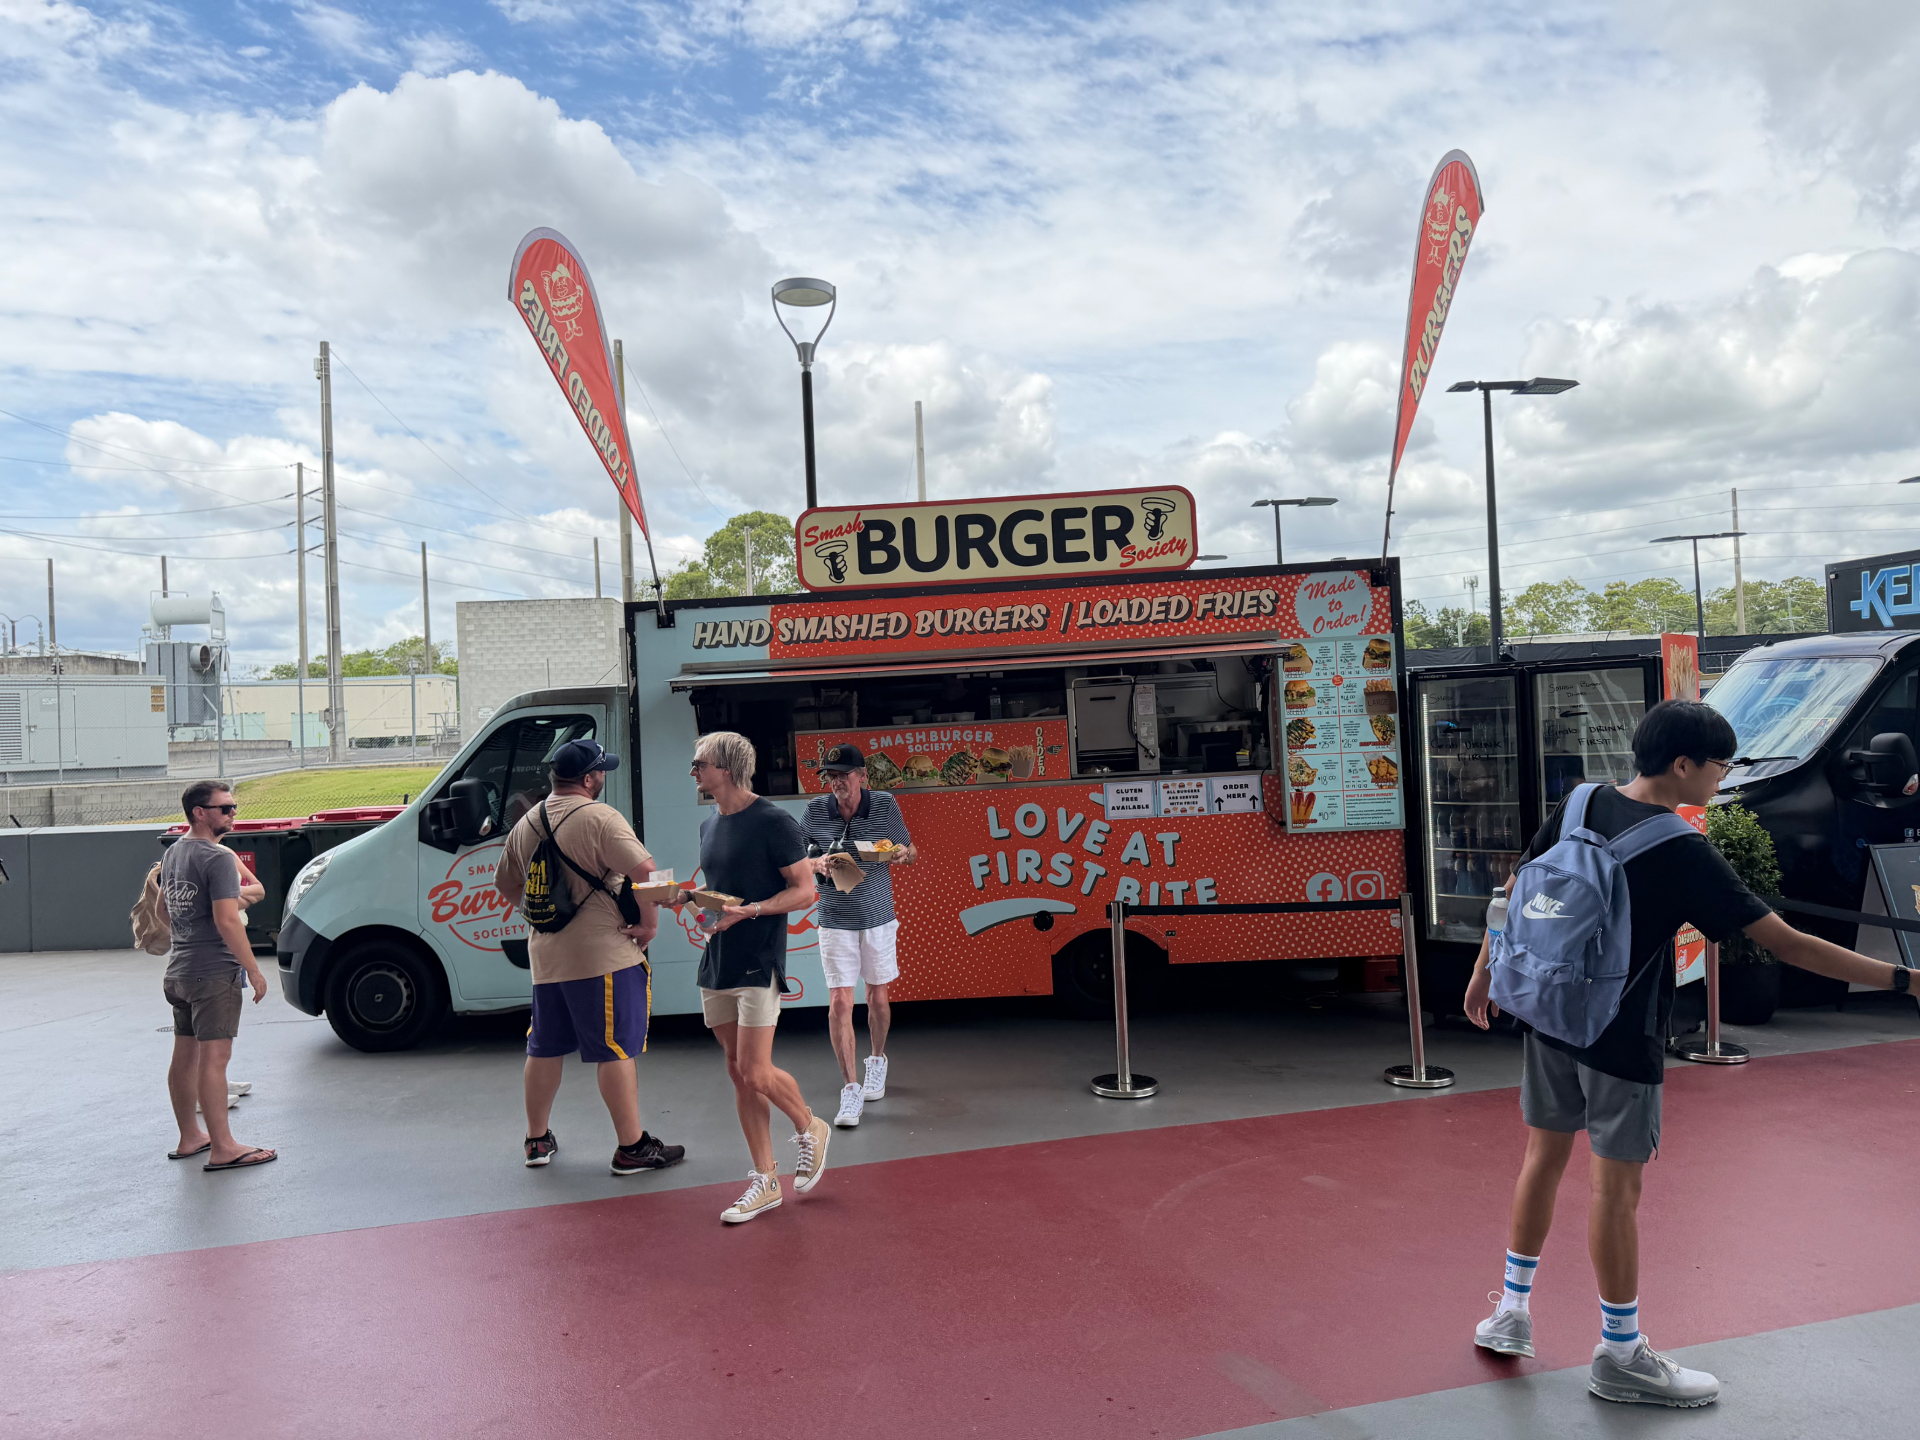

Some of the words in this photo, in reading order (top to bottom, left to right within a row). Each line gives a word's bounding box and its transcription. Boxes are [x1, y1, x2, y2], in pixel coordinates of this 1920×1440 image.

[1410, 205, 1473, 405] BURGERS
[803, 512, 864, 547] Smash
[856, 504, 1136, 575] BURGER
[1119, 535, 1188, 569] Society
[1303, 576, 1357, 601] Made
[1850, 564, 1920, 628] KE
[1328, 597, 1343, 614] to
[693, 618, 775, 649] HAND
[777, 610, 912, 645] SMASHED
[913, 603, 1050, 637] BURGERS
[1076, 594, 1194, 629] LOADED
[1195, 588, 1280, 621] FRIES
[1312, 604, 1368, 635] Order!
[1367, 698, 1389, 707] LARGE
[908, 742, 953, 753] SOCIETY
[1035, 726, 1046, 777] ORDER
[817, 738, 827, 790] COLLCT
[1115, 787, 1143, 795] GLUTEN
[1222, 783, 1250, 791] ORDER
[1226, 792, 1247, 800] HERE
[1111, 803, 1150, 811] AVAILABLE
[986, 802, 1113, 857] LOVE
[1119, 830, 1181, 868] AT
[239, 854, 251, 862] STE
[468, 862, 498, 876] SMA
[968, 848, 1109, 897] FIRST
[1113, 875, 1220, 906] BITE
[1532, 892, 1565, 915] NIKE
[473, 924, 526, 941] SOCIETY
[1605, 1316, 1622, 1326] NIKE
